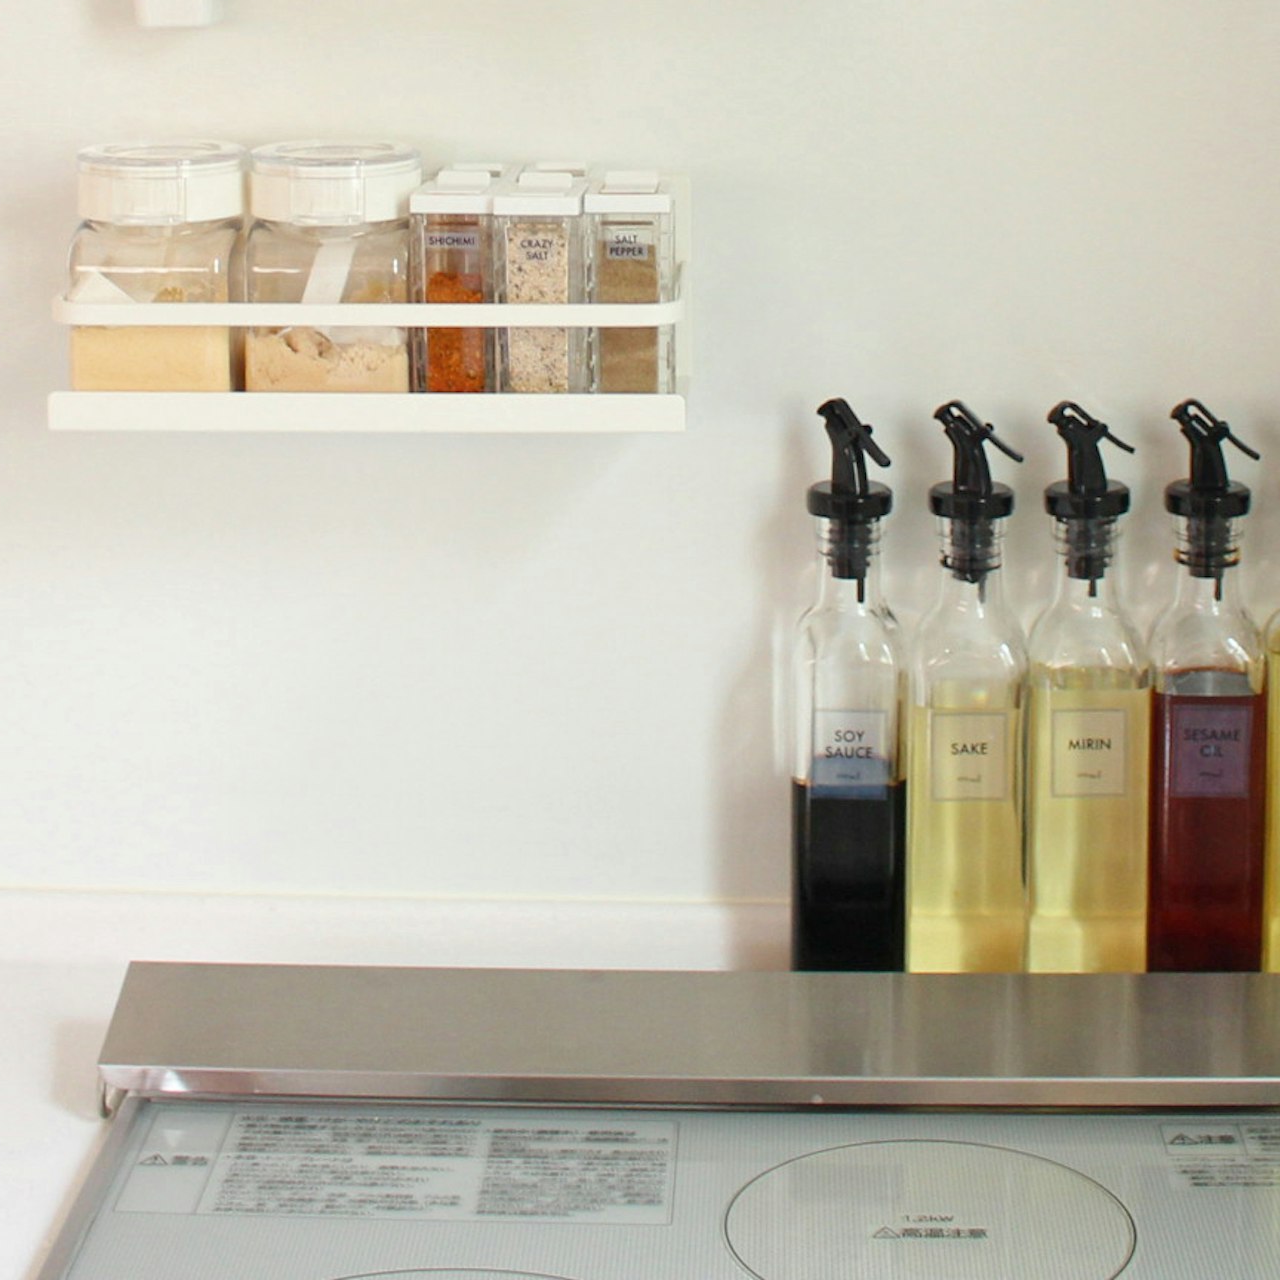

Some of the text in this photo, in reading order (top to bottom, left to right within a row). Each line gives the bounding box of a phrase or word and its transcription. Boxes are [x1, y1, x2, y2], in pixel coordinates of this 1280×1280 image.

[428, 236, 475, 246] SHICHIMI
[520, 239, 553, 250] CRAZY
[614, 235, 638, 245] SALT
[526, 251, 549, 261] SALT
[609, 246, 644, 257] PEPPER
[834, 730, 865, 743] SOY
[1183, 728, 1241, 742] SESAME
[951, 742, 989, 755] SAKE
[1068, 738, 1112, 751] MIRIN
[825, 746, 873, 759] SAUCE
[1200, 745, 1224, 758] OIL
